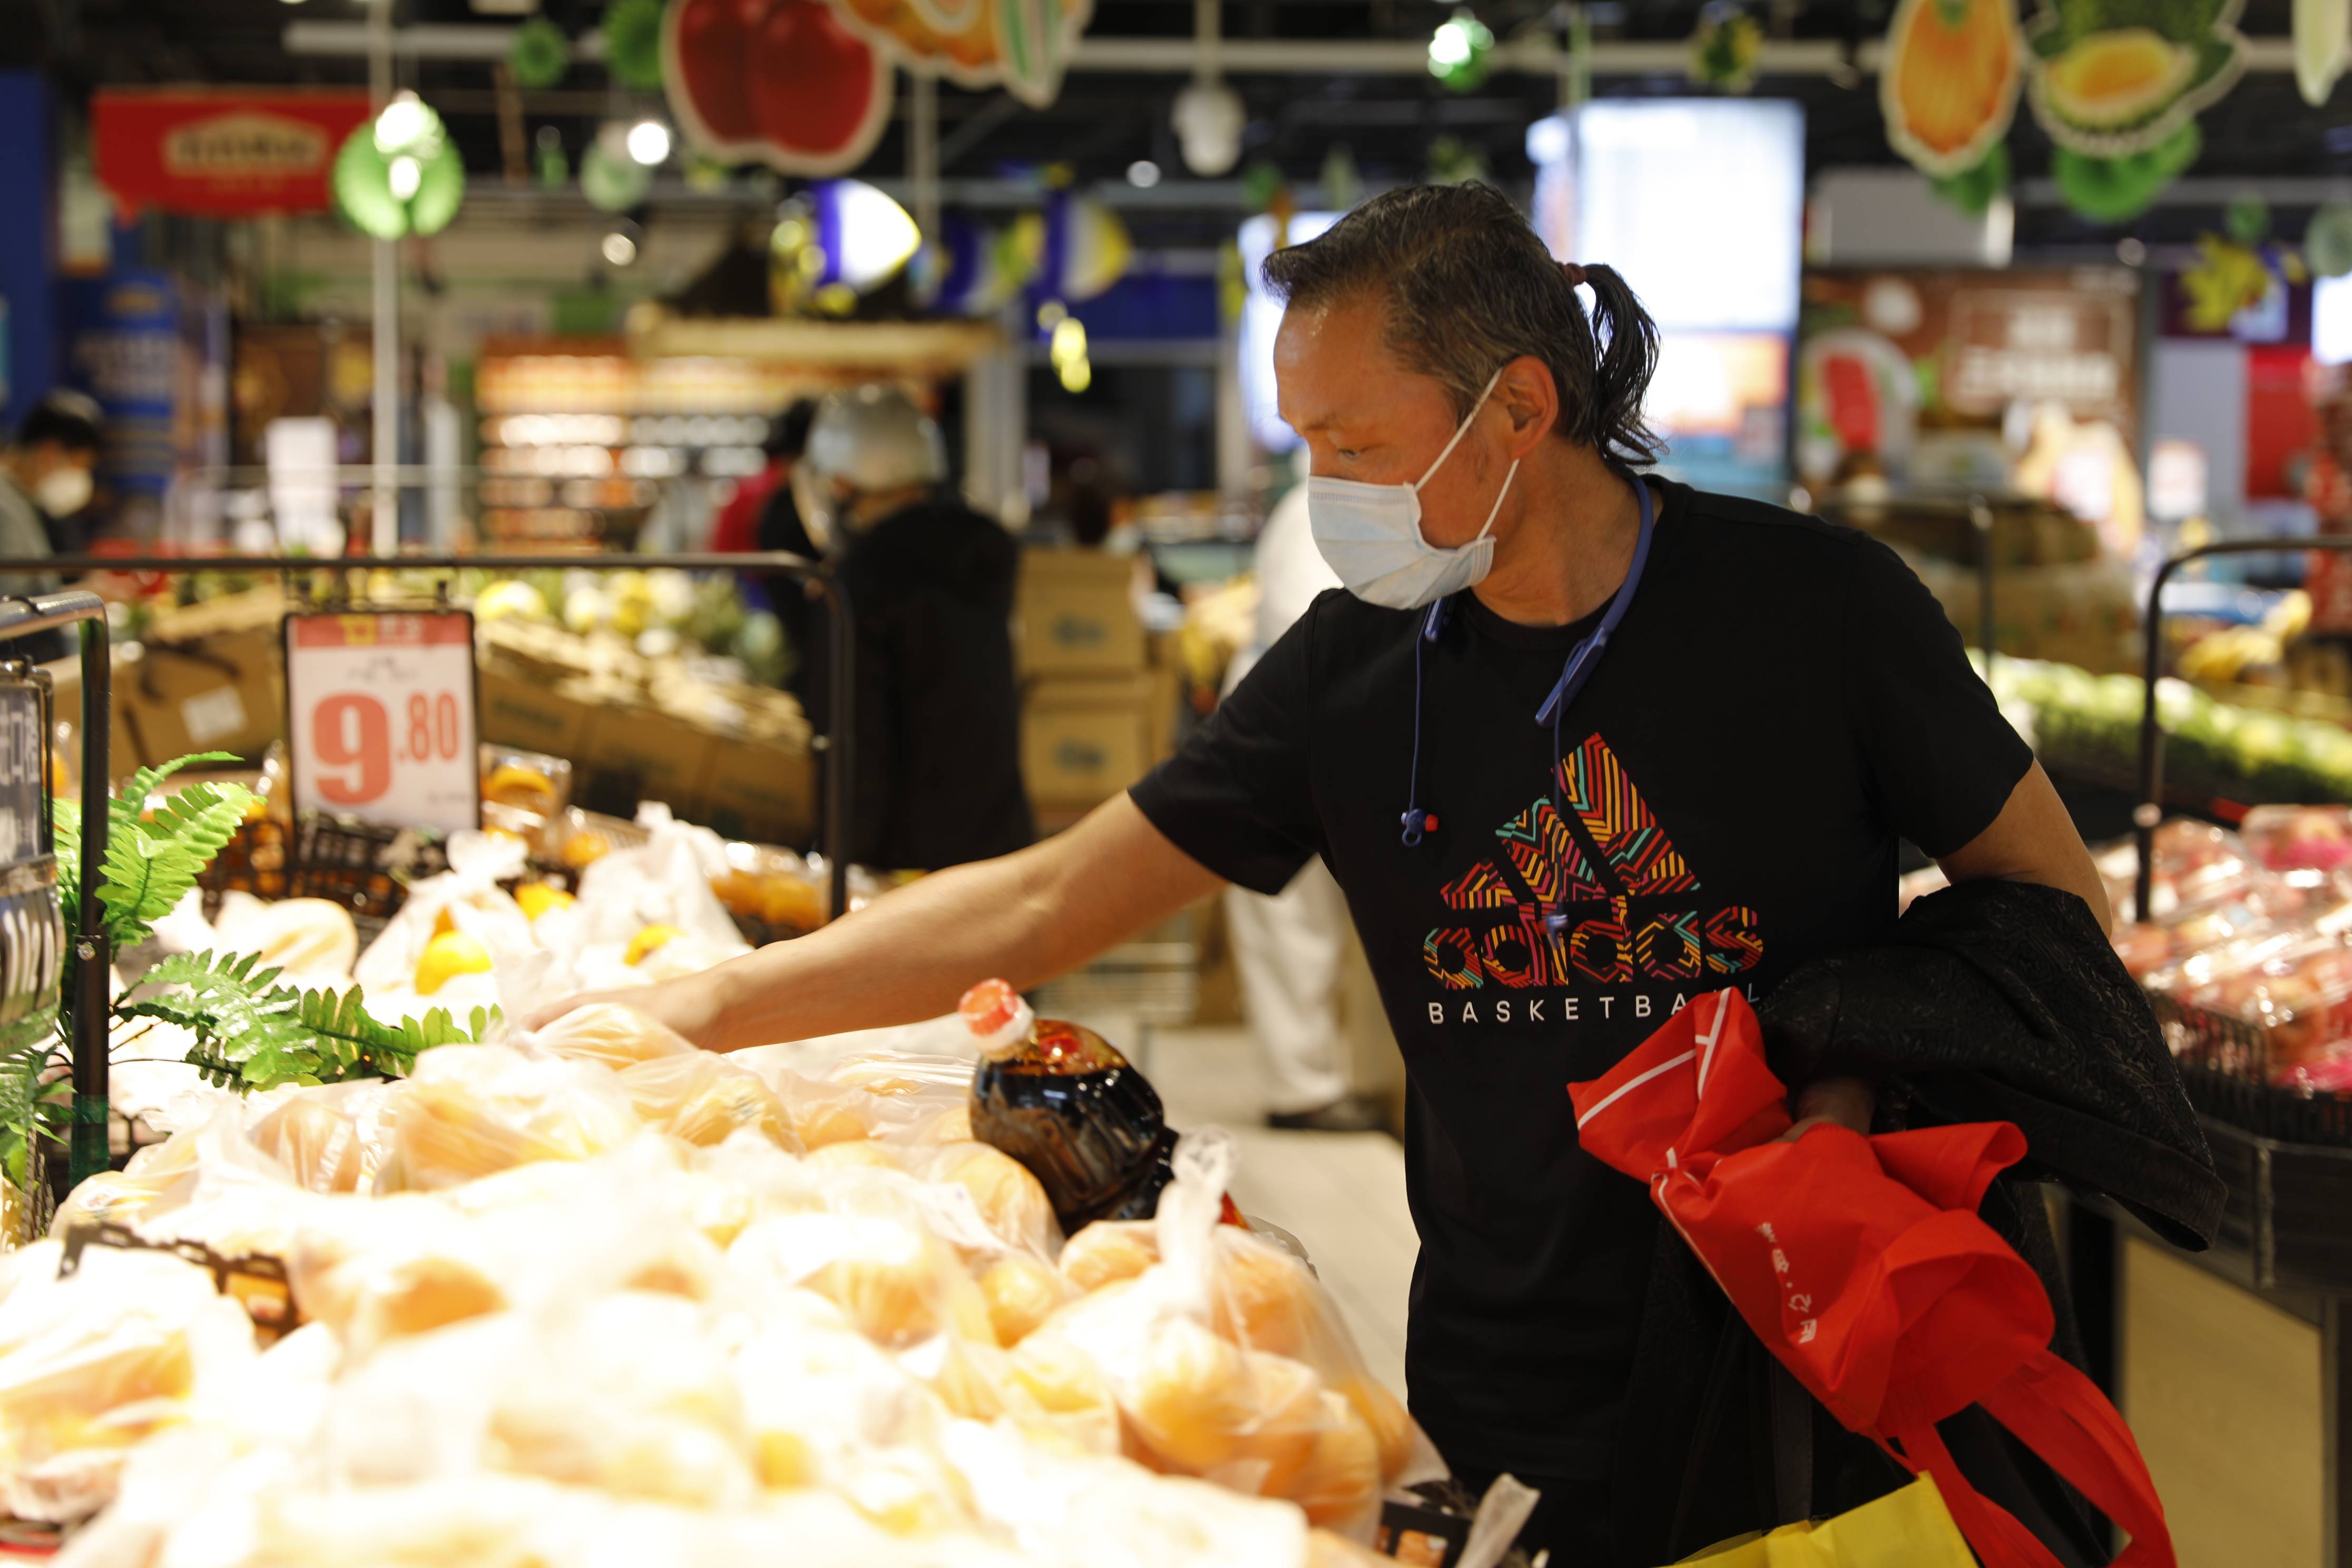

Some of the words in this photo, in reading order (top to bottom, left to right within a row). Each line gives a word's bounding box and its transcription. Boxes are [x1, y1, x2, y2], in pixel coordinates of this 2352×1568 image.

[312, 692, 458, 805] 9.80
[1423, 895, 1763, 990] adidas
[1428, 983, 1760, 1024] BASKETBAL
